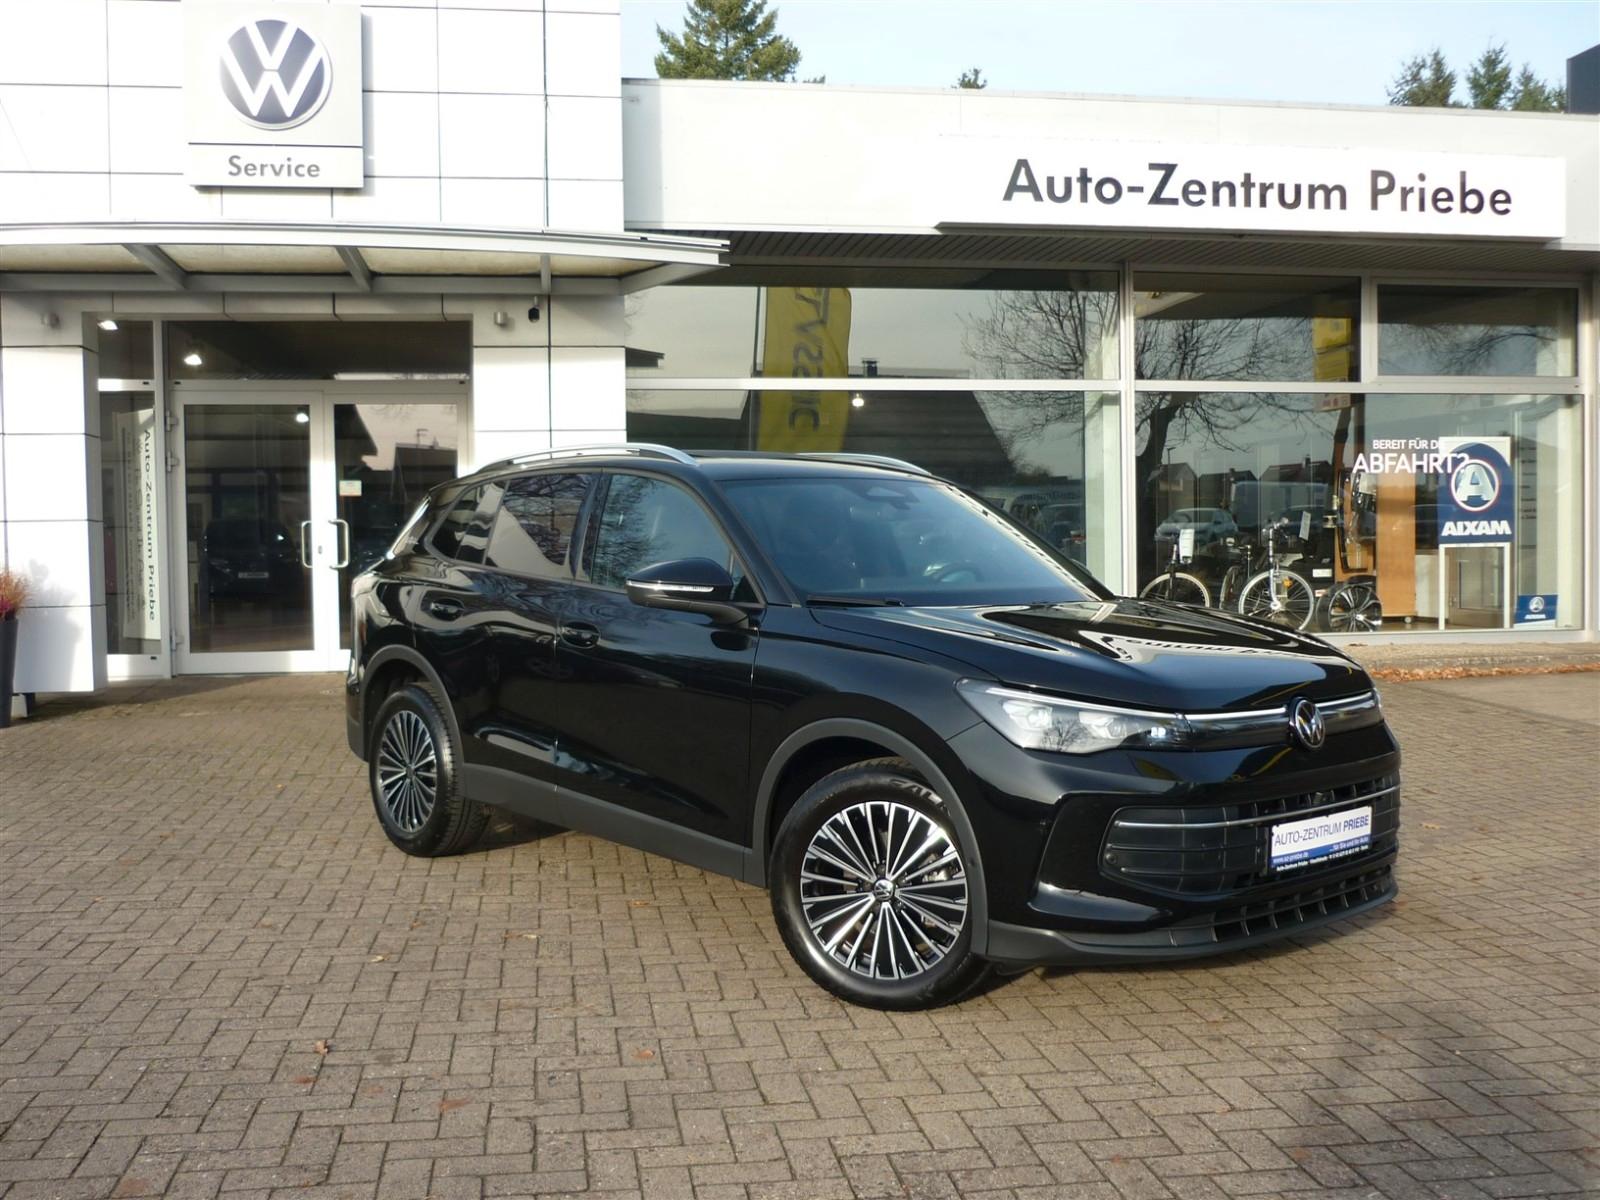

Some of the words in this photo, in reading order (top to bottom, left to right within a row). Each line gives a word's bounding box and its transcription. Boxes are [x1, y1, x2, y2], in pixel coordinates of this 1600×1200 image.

[228, 155, 320, 178] Service
[1003, 158, 1348, 210] Auto-Zentrum
[1371, 169, 1513, 216] Priebe
[1373, 439, 1407, 450] BEREIT
[1409, 437, 1429, 450] FÜR
[1352, 452, 1470, 474] ABFAHRT?
[144, 429, 153, 559] Auto-Zentrum
[1441, 519, 1513, 537] AIXAM
[1274, 822, 1342, 846] AUTO-ZENTRUM
[1344, 815, 1369, 832] PRIEBE
